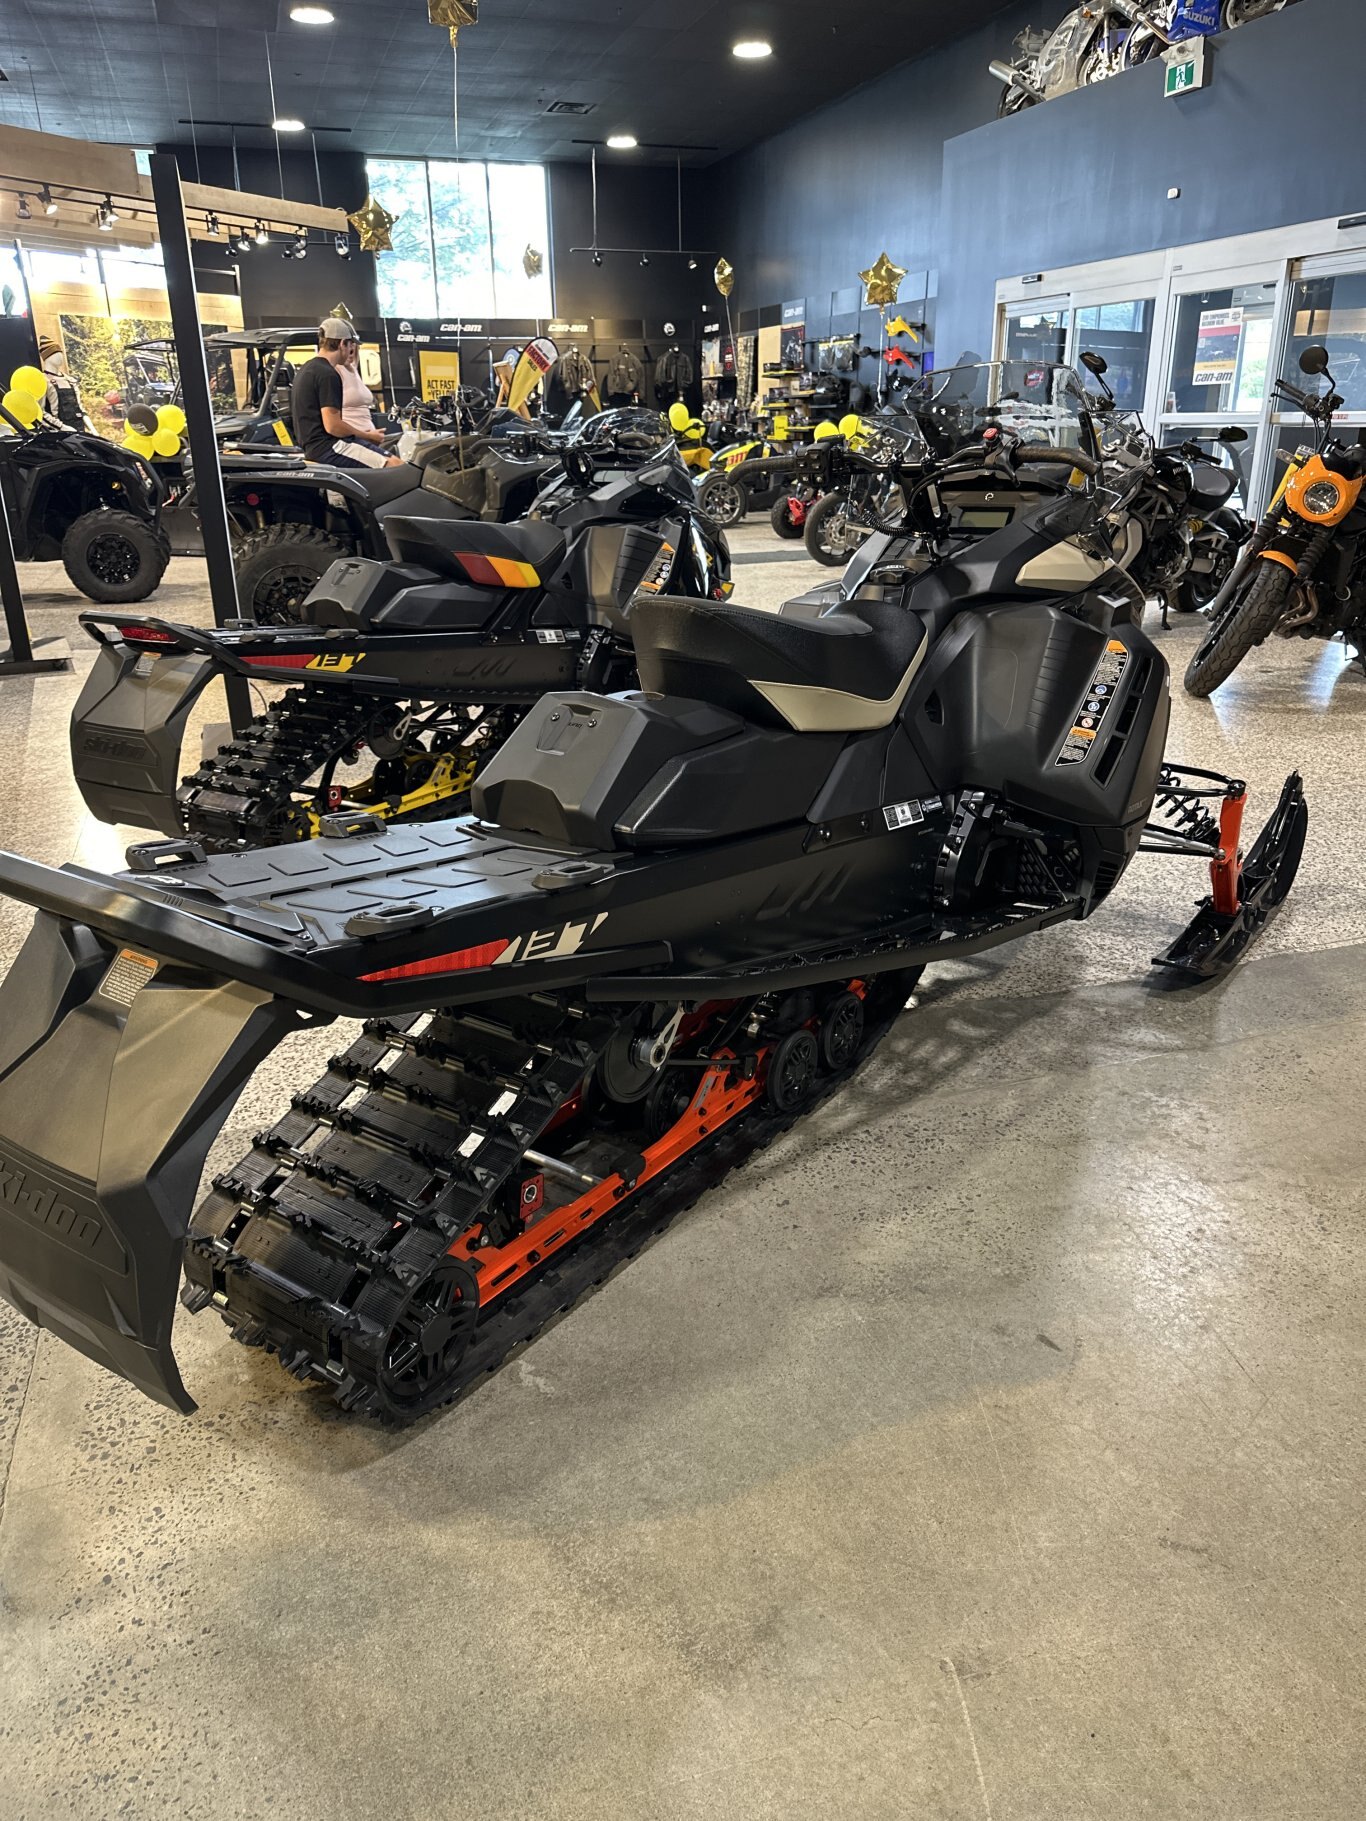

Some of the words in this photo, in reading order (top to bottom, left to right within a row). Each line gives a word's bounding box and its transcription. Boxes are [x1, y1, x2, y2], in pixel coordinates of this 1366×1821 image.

[1183, 11, 1215, 26] SUZUKI
[440, 323, 483, 332] can-am
[547, 323, 589, 333] can-am
[396, 334, 431, 343] can-am
[1195, 371, 1233, 383] can-am
[427, 379, 439, 389] ACT
[439, 379, 455, 390] FAST
[0, 1160, 103, 1249] ki-doo
